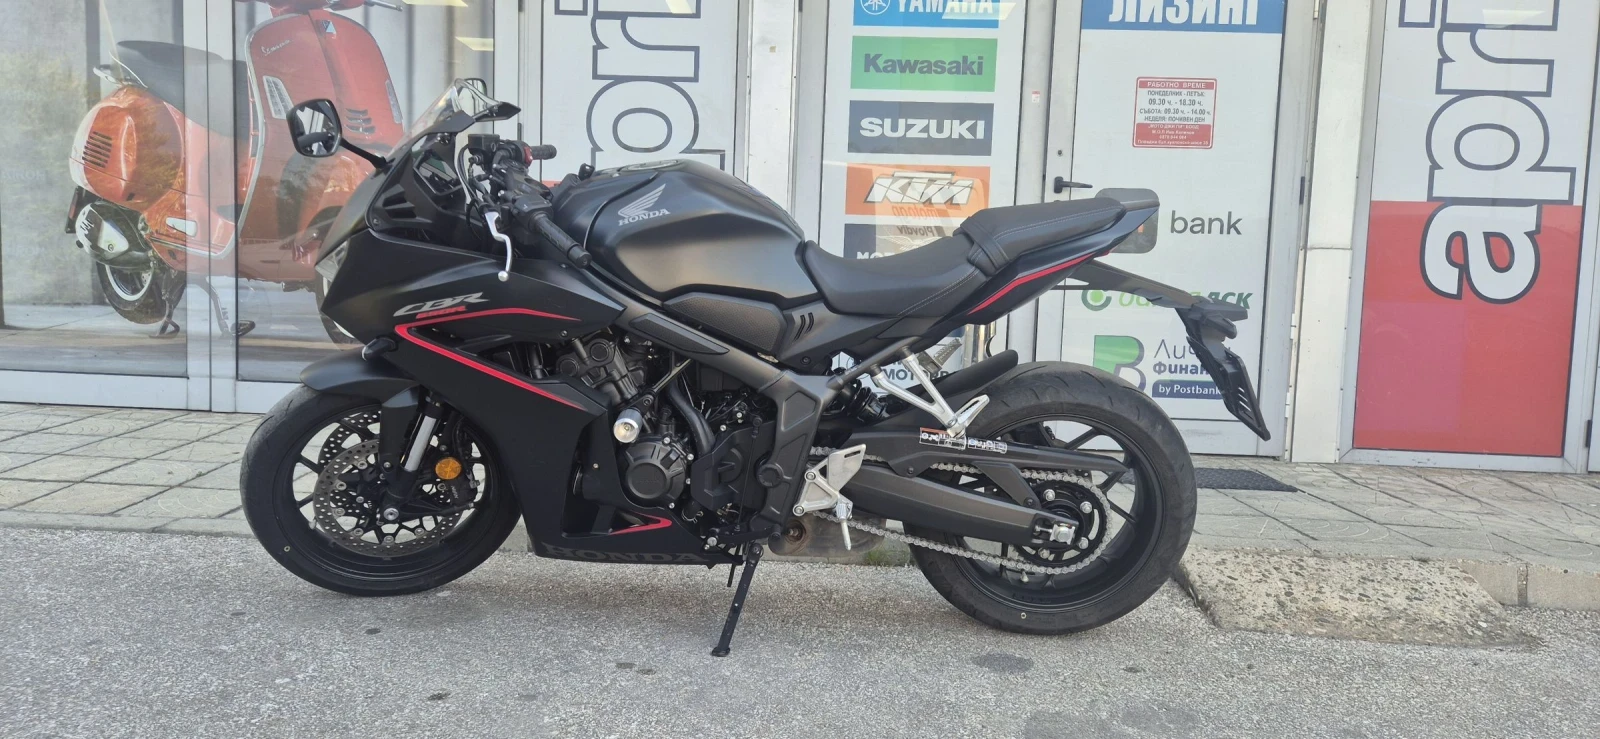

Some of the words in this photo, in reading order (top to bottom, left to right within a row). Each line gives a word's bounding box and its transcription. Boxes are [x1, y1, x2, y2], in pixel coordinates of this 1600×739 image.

[898, 0, 994, 14] YAMAHA
[863, 53, 984, 76] Kawasaki
[1148, 98, 1166, 106] 09.30
[1179, 99, 1196, 107] 18.30
[859, 117, 985, 139] SUZUKI
[864, 171, 975, 206] KTM
[618, 208, 671, 226] HONDA
[1170, 210, 1243, 236] bank
[393, 292, 490, 317] CBR
[1158, 384, 1171, 398] by
[541, 542, 709, 562] HONDA
